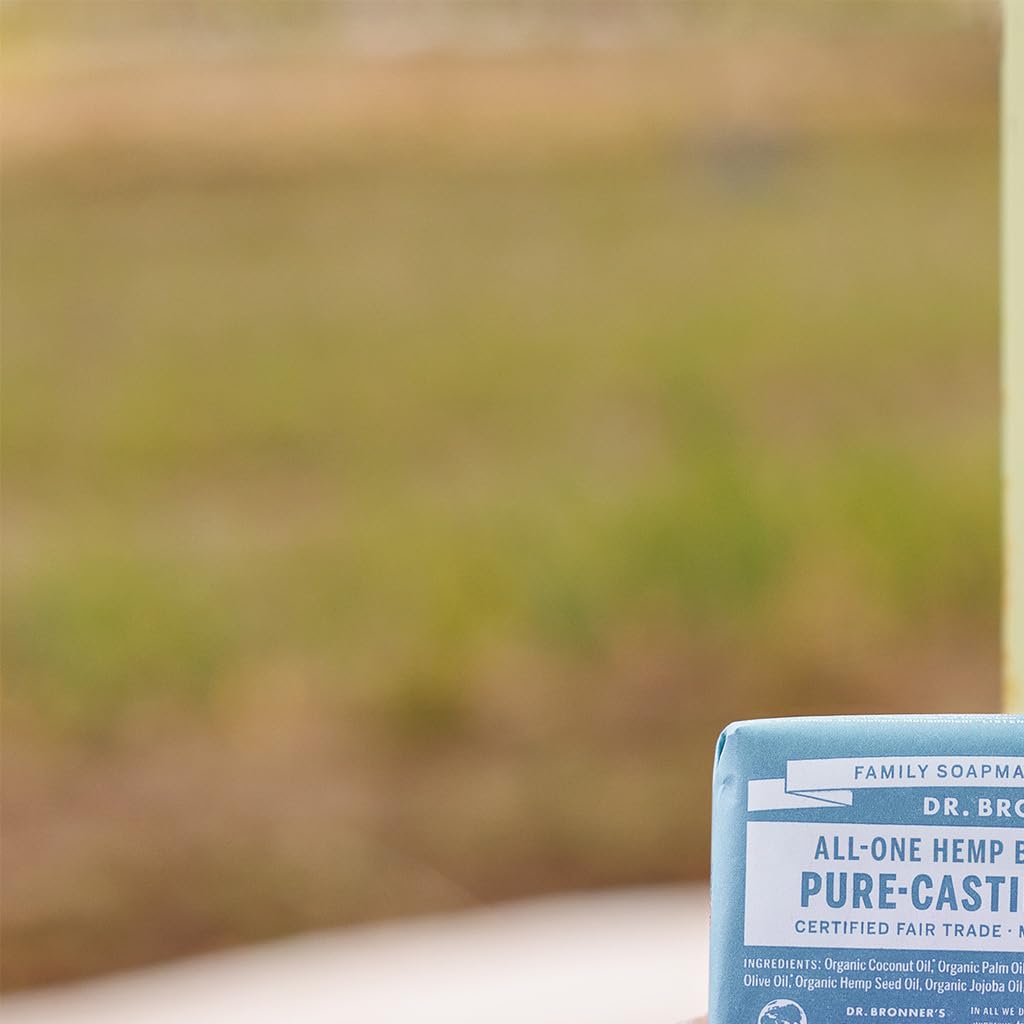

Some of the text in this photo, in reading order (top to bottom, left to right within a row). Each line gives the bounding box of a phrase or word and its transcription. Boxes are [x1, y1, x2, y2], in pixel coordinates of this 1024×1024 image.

[854, 764, 929, 780] FAMILY
[923, 797, 969, 817] DR.
[814, 835, 922, 862] ALL-ONE
[933, 838, 1004, 864] HEMP
[794, 920, 890, 935] CERTIFIED
[896, 922, 936, 937] FAIR
[942, 923, 1002, 938] TRADE
[743, 958, 822, 971] INGREDIENTS:
[824, 957, 866, 974] Organic
[868, 958, 914, 973] Coconut
[938, 960, 980, 976] Organic
[982, 961, 1009, 975] Palm
[743, 974, 771, 988] Olive
[795, 975, 838, 992] Organic
[840, 976, 872, 992] Hemp
[875, 977, 901, 990] Seed
[925, 978, 967, 995] Organic
[969, 979, 1005, 995] Jojoba
[846, 1007, 946, 1018] DR. BRONNER'S
[970, 1006, 980, 1015] IN
[982, 1007, 999, 1016] ALL
[1002, 1007, 1015, 1016] WE
